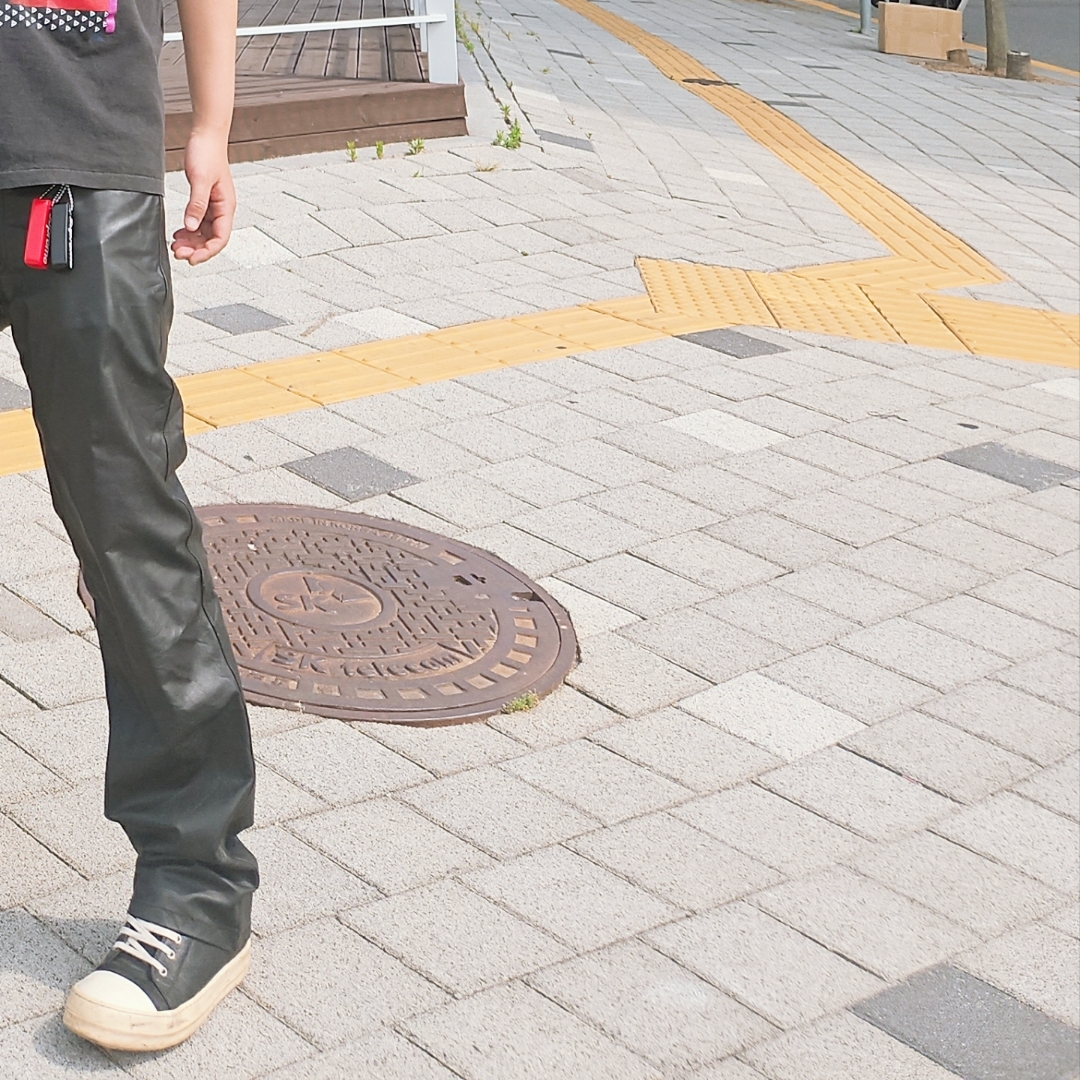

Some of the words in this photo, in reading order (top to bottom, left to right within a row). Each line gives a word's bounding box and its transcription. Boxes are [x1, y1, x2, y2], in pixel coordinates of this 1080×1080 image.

[273, 587, 338, 614] SK
[270, 650, 329, 674] SK
[338, 654, 462, 678] telecom
